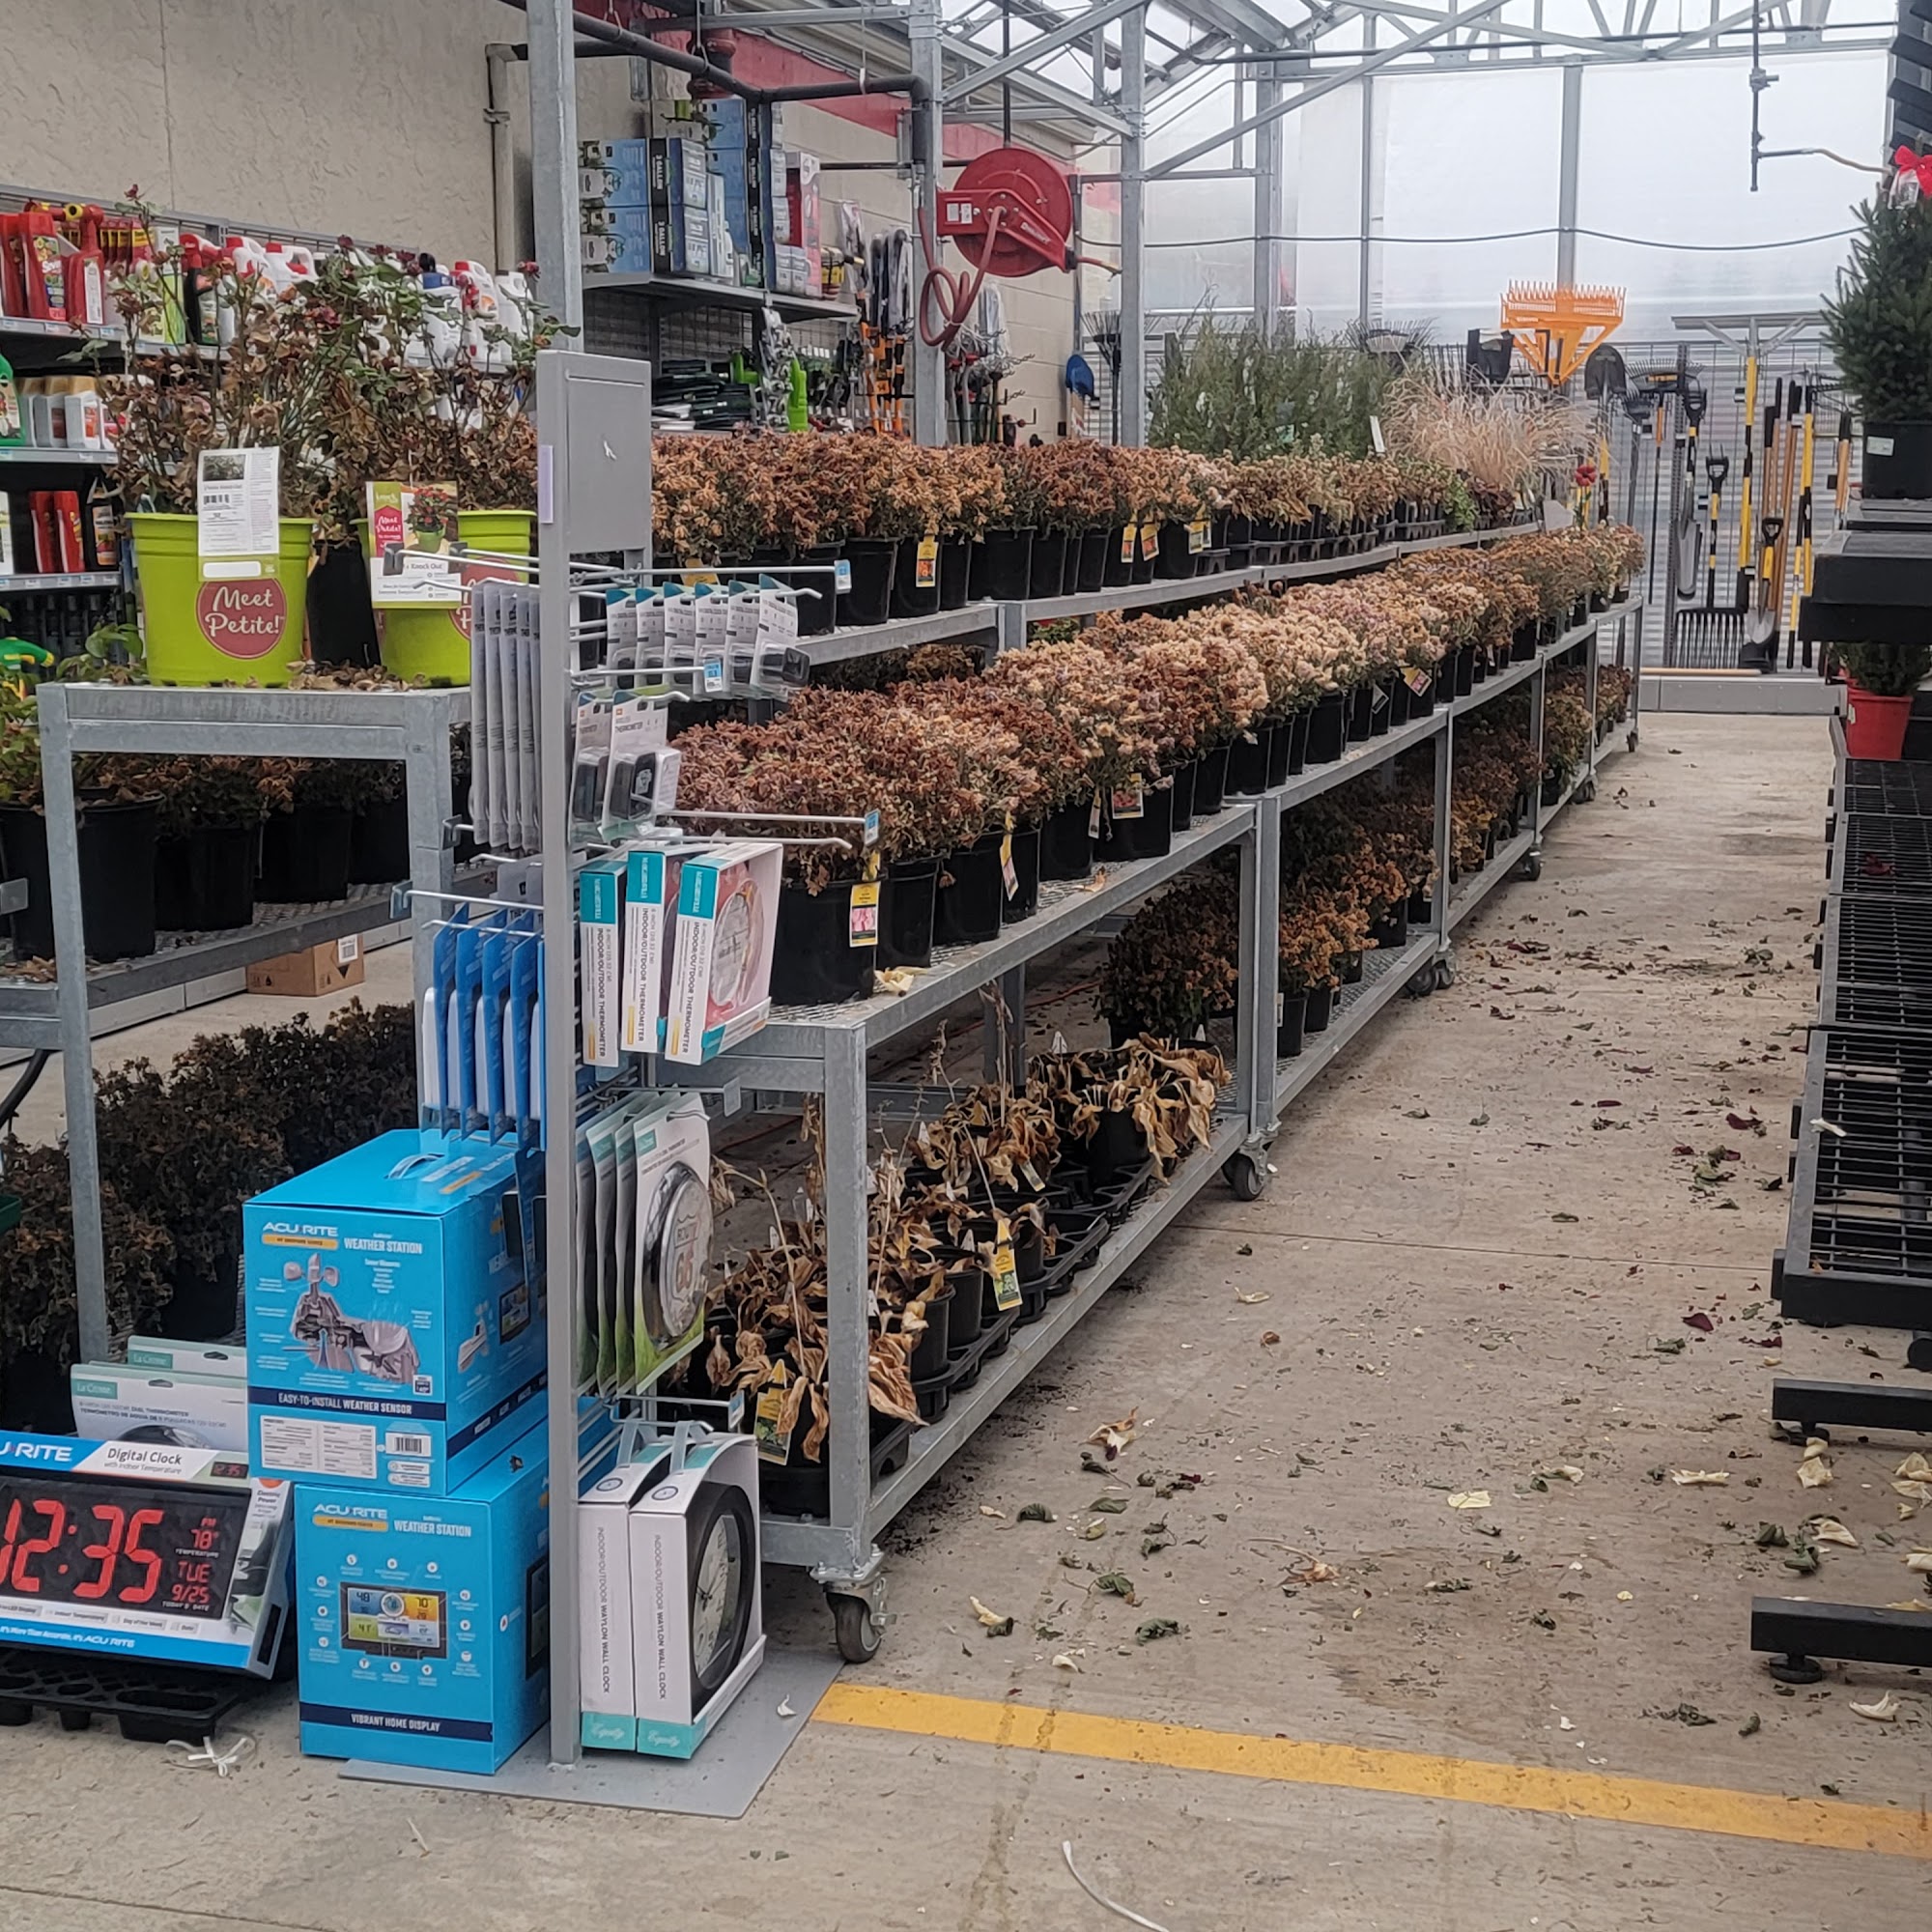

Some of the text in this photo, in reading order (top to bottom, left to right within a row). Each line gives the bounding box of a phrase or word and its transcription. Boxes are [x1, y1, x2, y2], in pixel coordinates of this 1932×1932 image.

[213, 585, 273, 611] Meet
[205, 612, 279, 637] Petite!
[639, 908, 649, 1041] INDOOR/OUTDOOR THERMOMETER
[682, 922, 699, 1053] INDOOR/OUTDOOR THERMOMETER
[344, 1237, 422, 1255] WEATHER STATION
[278, 1393, 412, 1414] EASY-TO-INSTALL WEATHER SENSOR
[107, 1448, 183, 1465] Digital Clock
[140, 1463, 182, 1475] Temperature
[394, 1520, 471, 1537] WEATHER STATION
[175, 1548, 219, 1558] TEMPERATURE
[178, 1561, 210, 1583] TUE
[597, 1527, 608, 1604] INDOOR/OUTDOOR
[654, 1534, 665, 1609] INDOOR/OUTDOOR
[171, 1584, 210, 1604] 9/25
[600, 1605, 609, 1639] WAYLON
[656, 1611, 666, 1646] WAYLON
[658, 1648, 667, 1670] WALL
[602, 1665, 611, 1693] CLOCK
[351, 1714, 440, 1732] VIBRANT HOME DISPLAY
